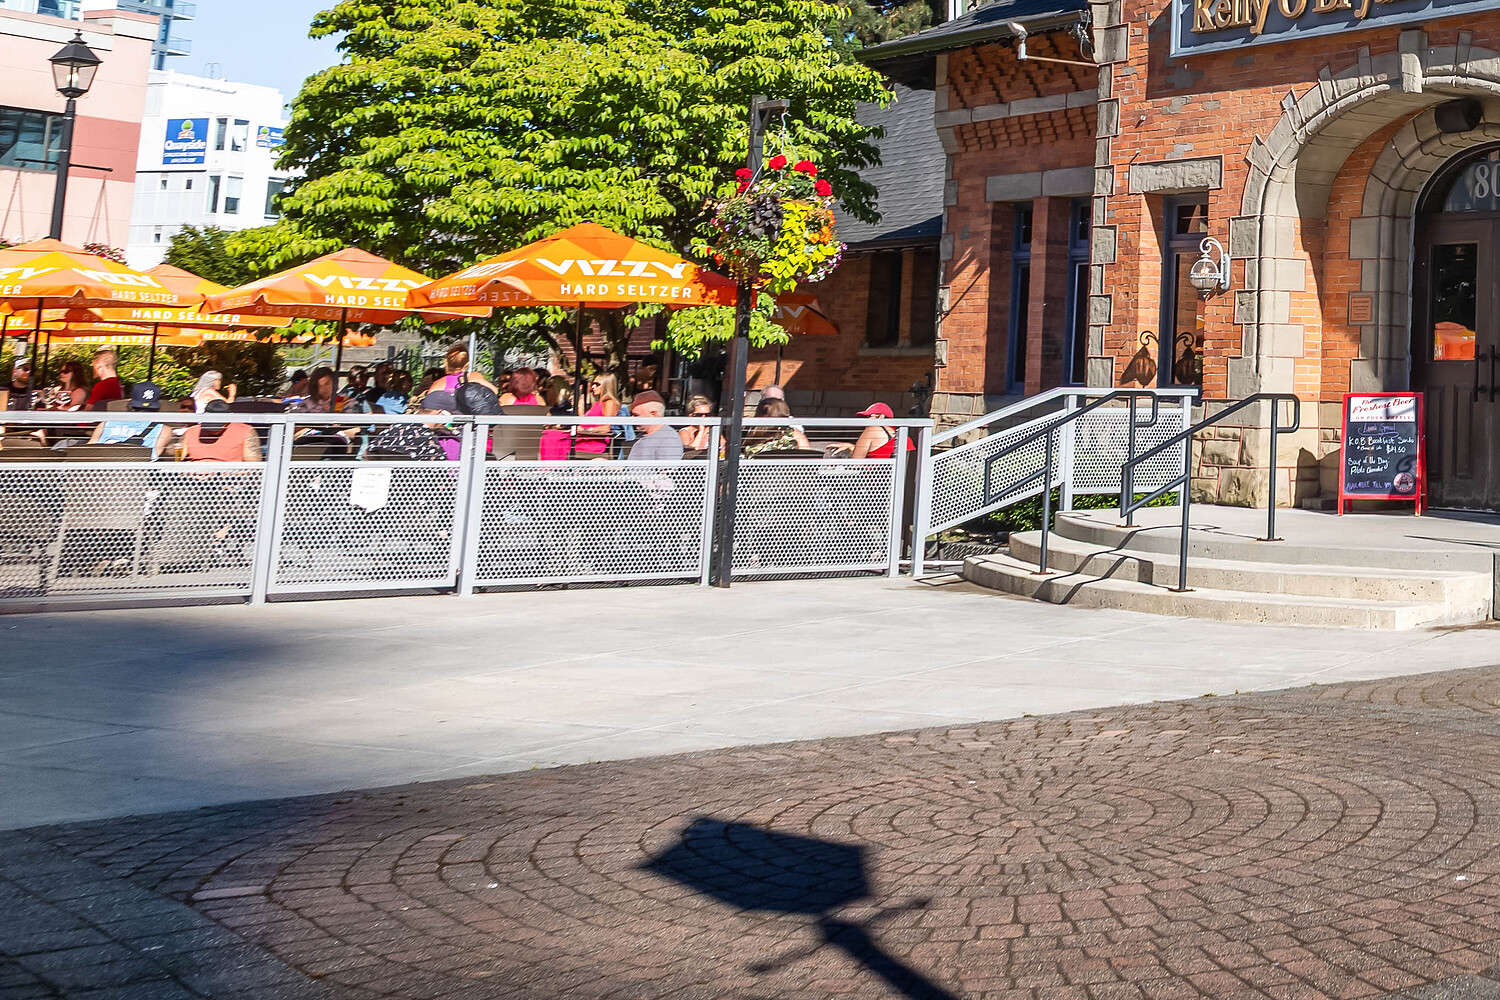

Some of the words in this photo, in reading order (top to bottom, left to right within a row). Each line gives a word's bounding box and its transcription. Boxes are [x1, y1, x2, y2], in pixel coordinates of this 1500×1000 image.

[535, 258, 687, 279] VIZZY
[303, 273, 433, 292] VIZZY
[111, 290, 137, 301] HARD
[139, 291, 179, 304] SELTZER
[560, 283, 608, 296] HARD
[616, 284, 692, 298] SELTZER
[325, 294, 367, 306] HARD
[131, 309, 172, 320] HARD
[178, 311, 241, 324] SELTZER
[110, 335, 160, 344] SELTZE
[1352, 402, 1391, 413] Freshest
[1392, 398, 1413, 407] Beer
